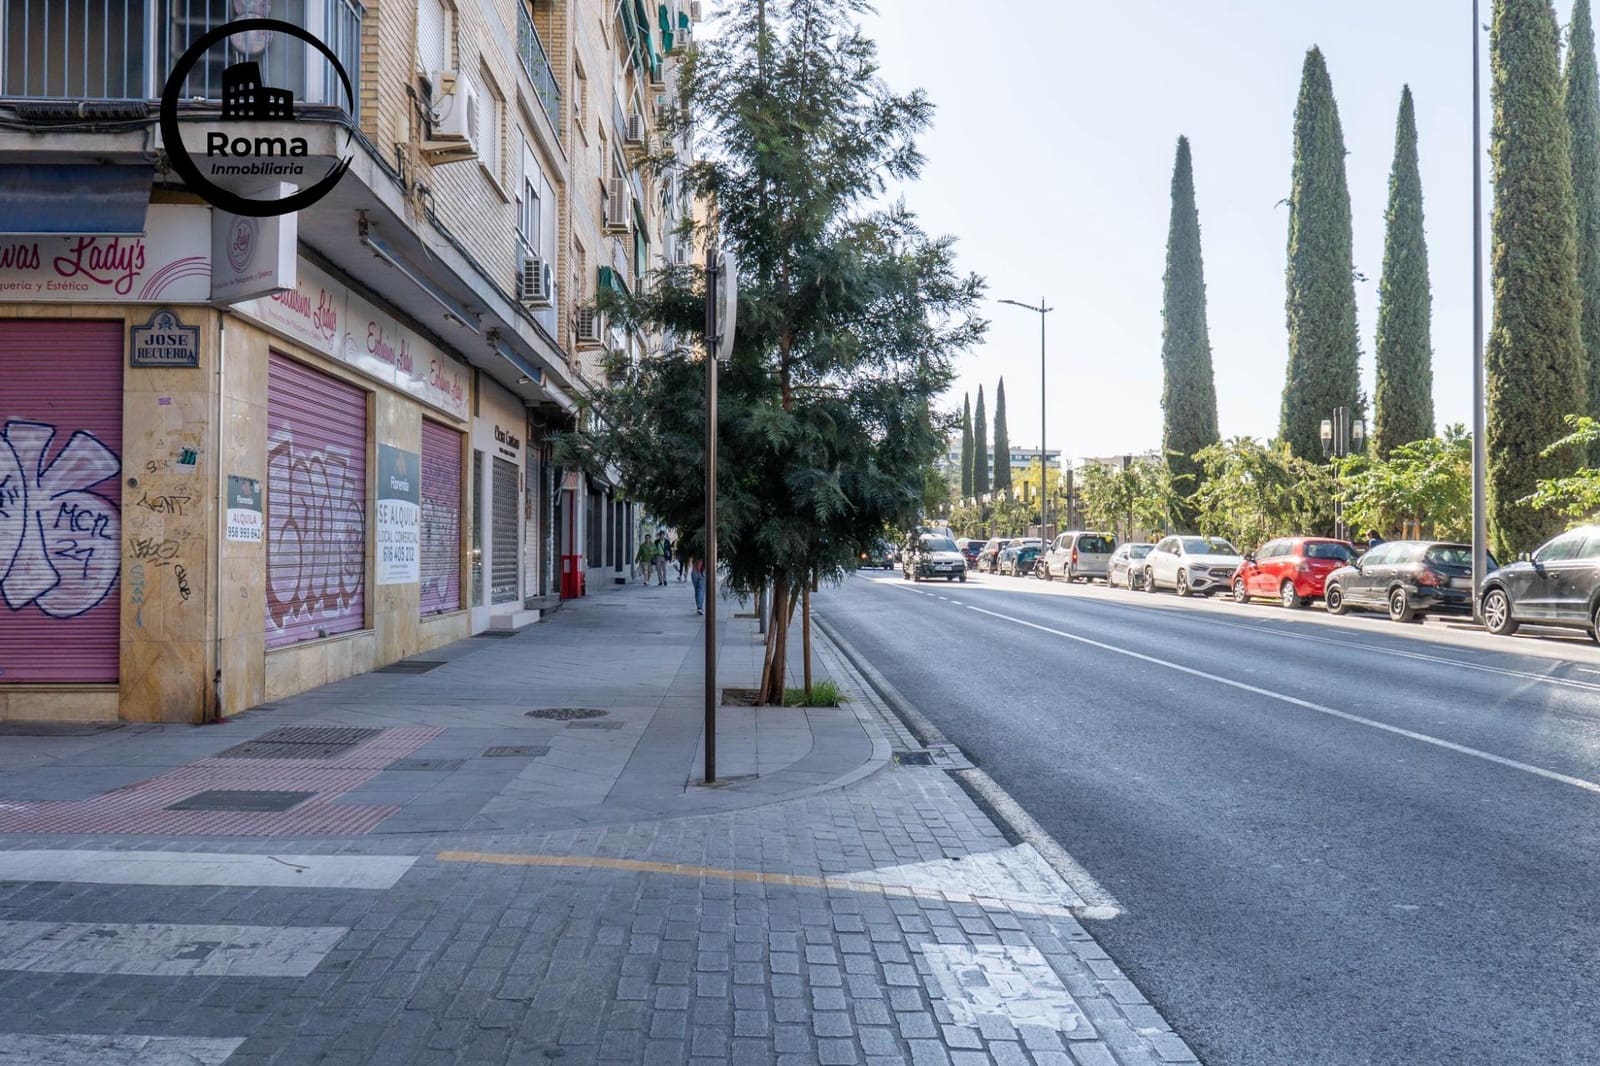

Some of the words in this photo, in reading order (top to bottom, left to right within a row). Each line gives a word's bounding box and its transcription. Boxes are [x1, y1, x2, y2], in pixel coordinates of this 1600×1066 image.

[37, 283, 42, 292] y
[47, 281, 89, 291] Estética
[144, 334, 188, 346] JOSE
[137, 347, 195, 362] RECUERDA
[379, 504, 388, 524] SE
[390, 505, 418, 528] ALQUILA
